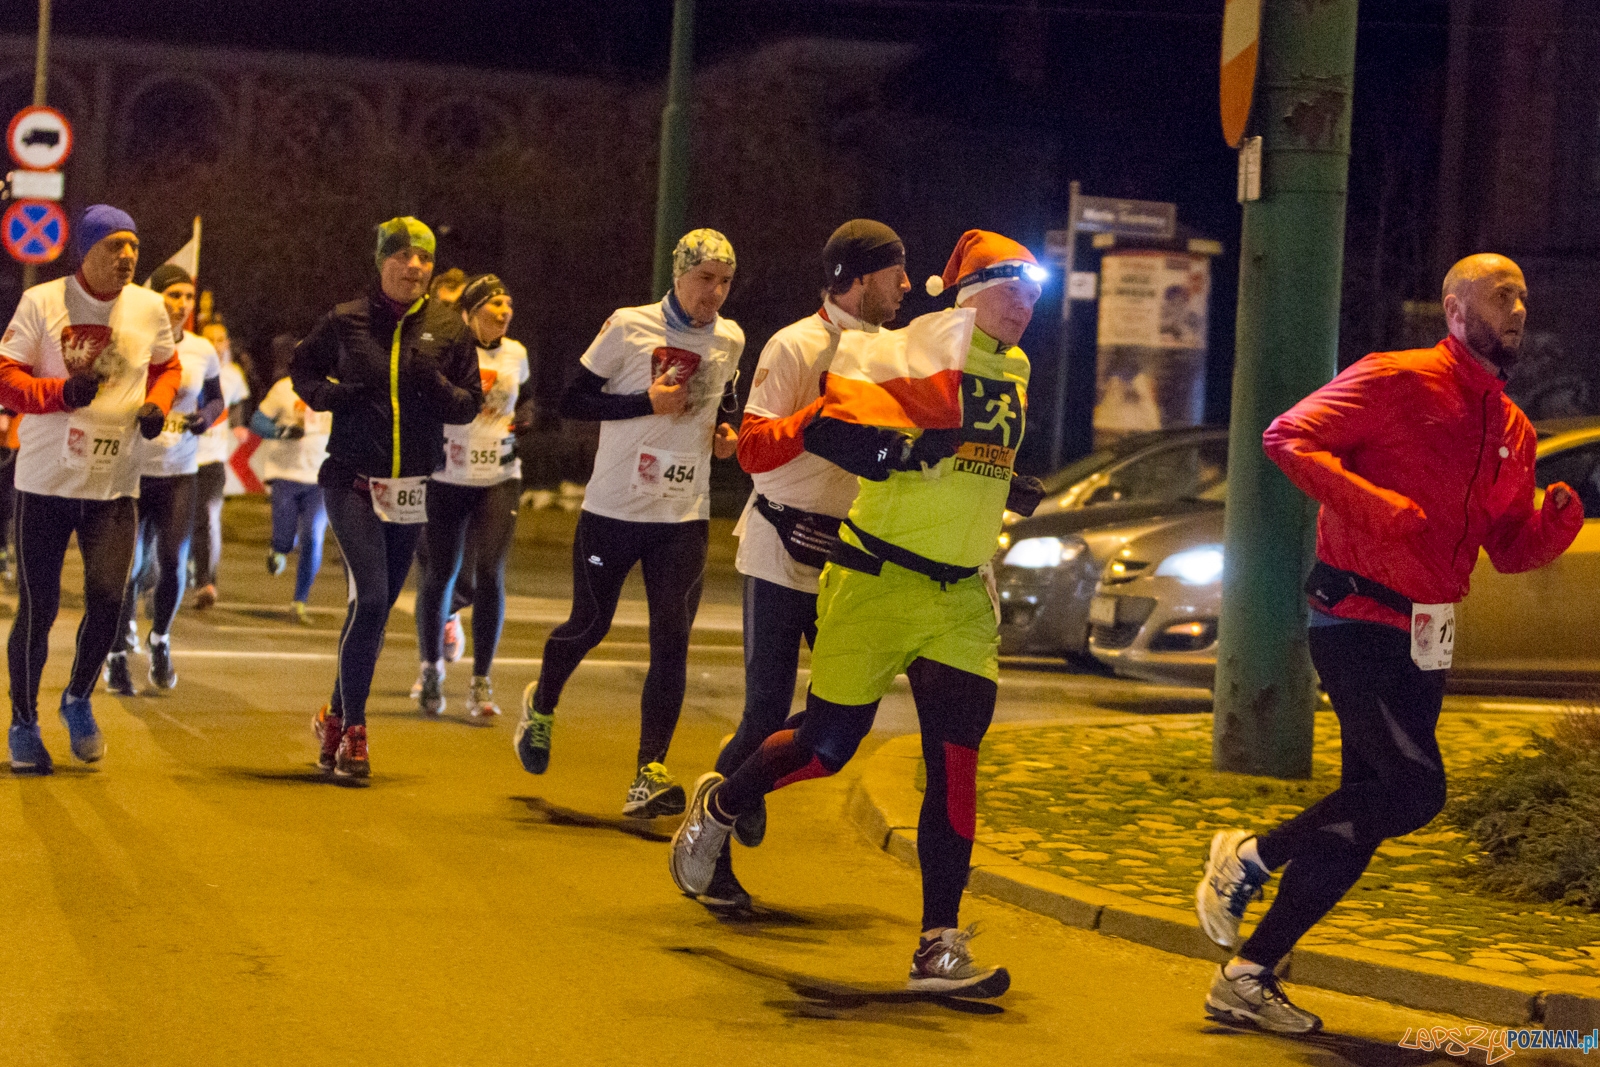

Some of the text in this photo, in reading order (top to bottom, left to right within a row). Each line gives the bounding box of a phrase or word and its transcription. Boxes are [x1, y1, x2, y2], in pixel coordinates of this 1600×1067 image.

[93, 438, 120, 456] 778
[470, 449, 497, 464] 355
[973, 444, 1009, 463] night
[663, 464, 695, 483] 454
[954, 458, 1011, 480] runners
[397, 487, 423, 507] 862
